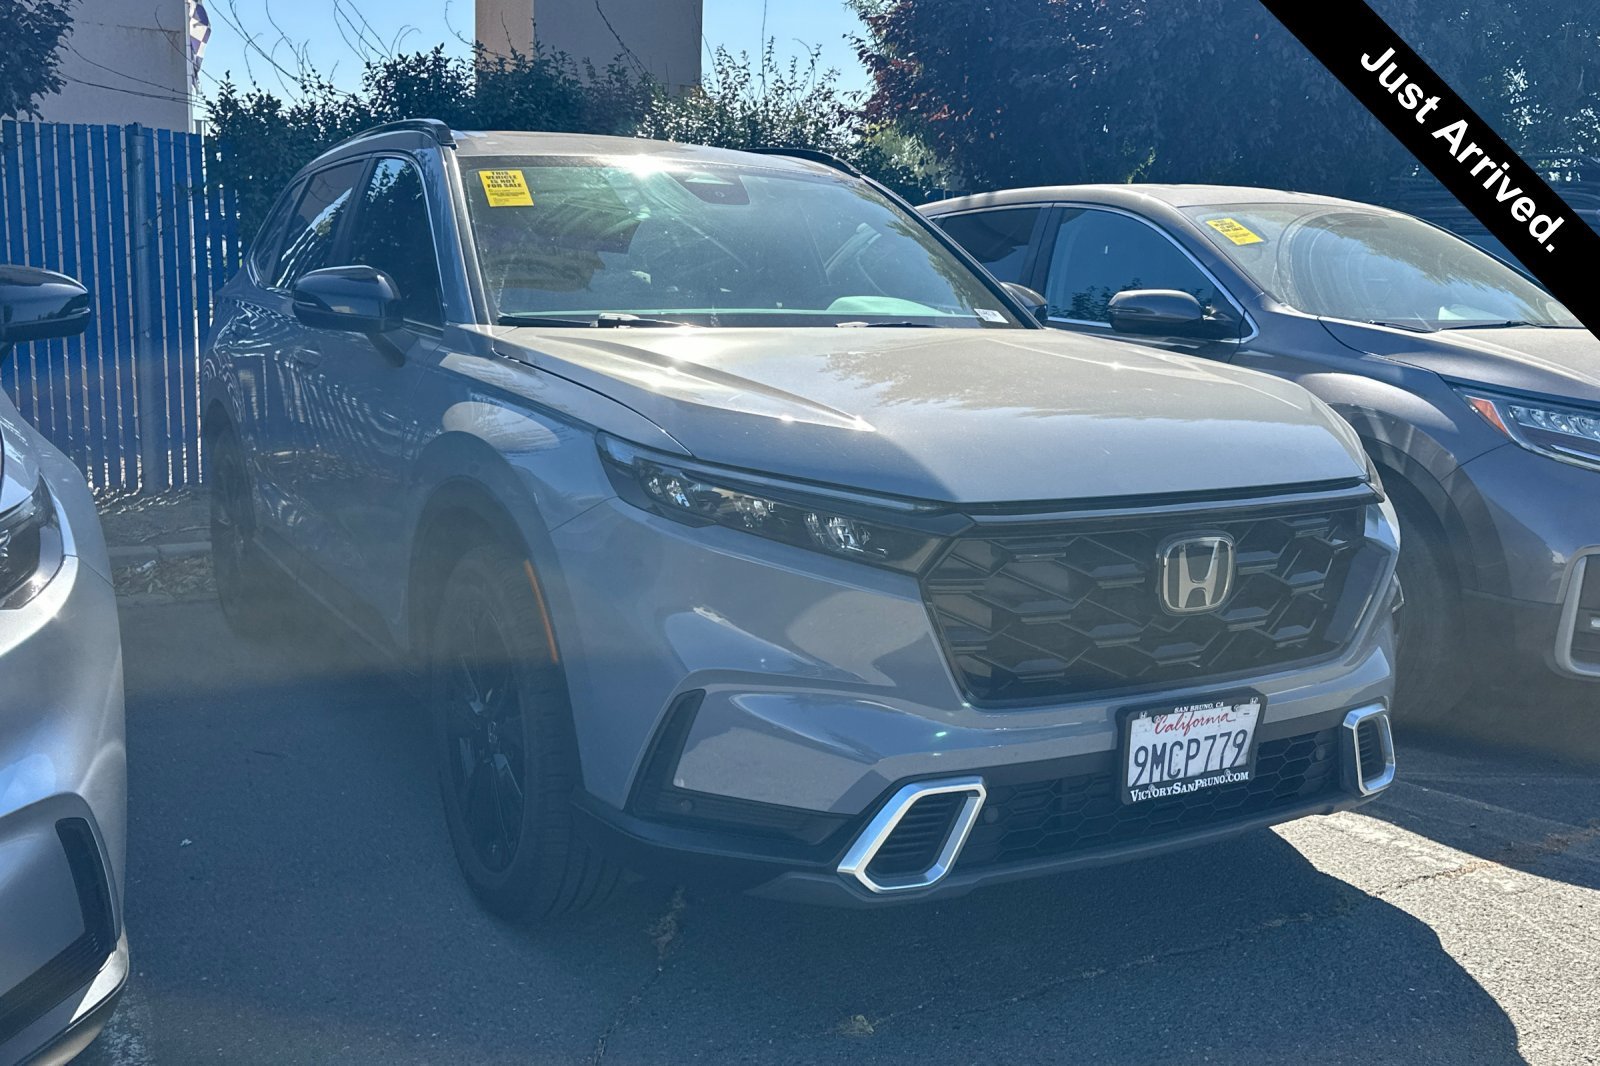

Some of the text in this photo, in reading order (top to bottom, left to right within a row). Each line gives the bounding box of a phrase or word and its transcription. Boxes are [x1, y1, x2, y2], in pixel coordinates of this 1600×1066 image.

[1174, 705, 1189, 714] SAN
[1154, 712, 1236, 737] California
[1132, 728, 1248, 786] 9MCP779
